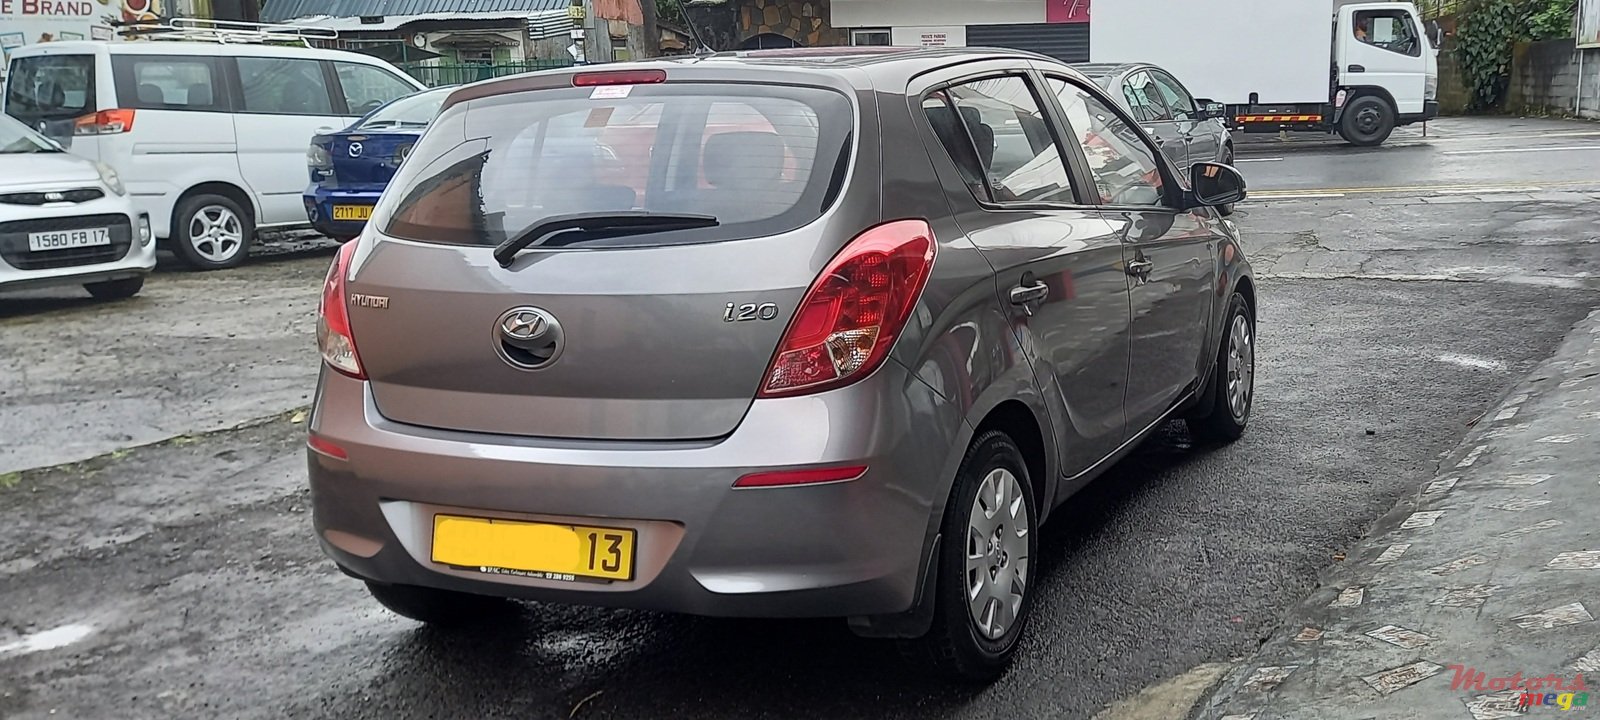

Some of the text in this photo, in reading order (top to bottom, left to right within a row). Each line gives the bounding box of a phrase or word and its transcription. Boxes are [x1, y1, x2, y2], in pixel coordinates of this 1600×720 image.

[22, 0, 93, 16] BRAND
[335, 207, 368, 218] 2717 JU
[36, 233, 68, 248] 1580
[93, 229, 106, 243] 17
[351, 293, 390, 310] HYUNDAI
[723, 301, 779, 322] i20
[588, 532, 623, 573] 13
